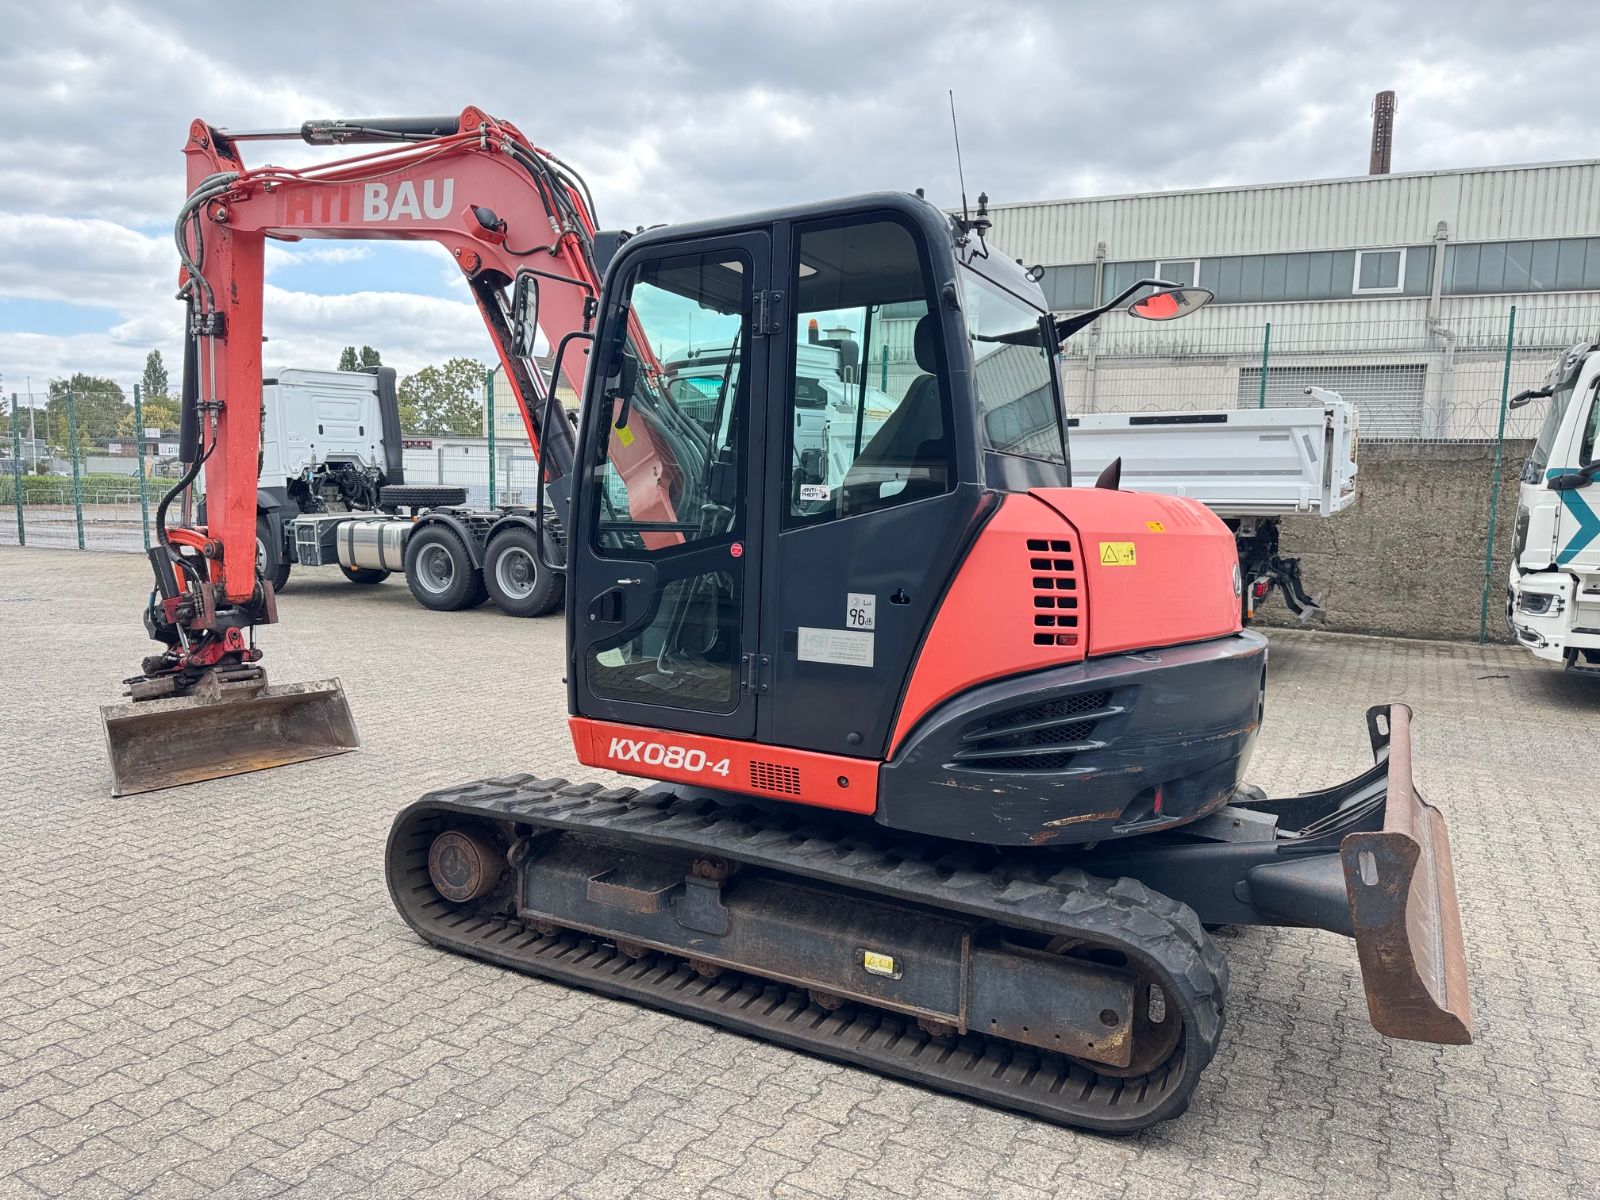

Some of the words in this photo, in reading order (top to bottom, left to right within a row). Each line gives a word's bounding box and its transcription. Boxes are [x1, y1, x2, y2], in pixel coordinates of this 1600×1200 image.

[363, 178, 454, 222] BAU
[849, 608, 865, 626] 96
[608, 737, 730, 776] KX080-4
